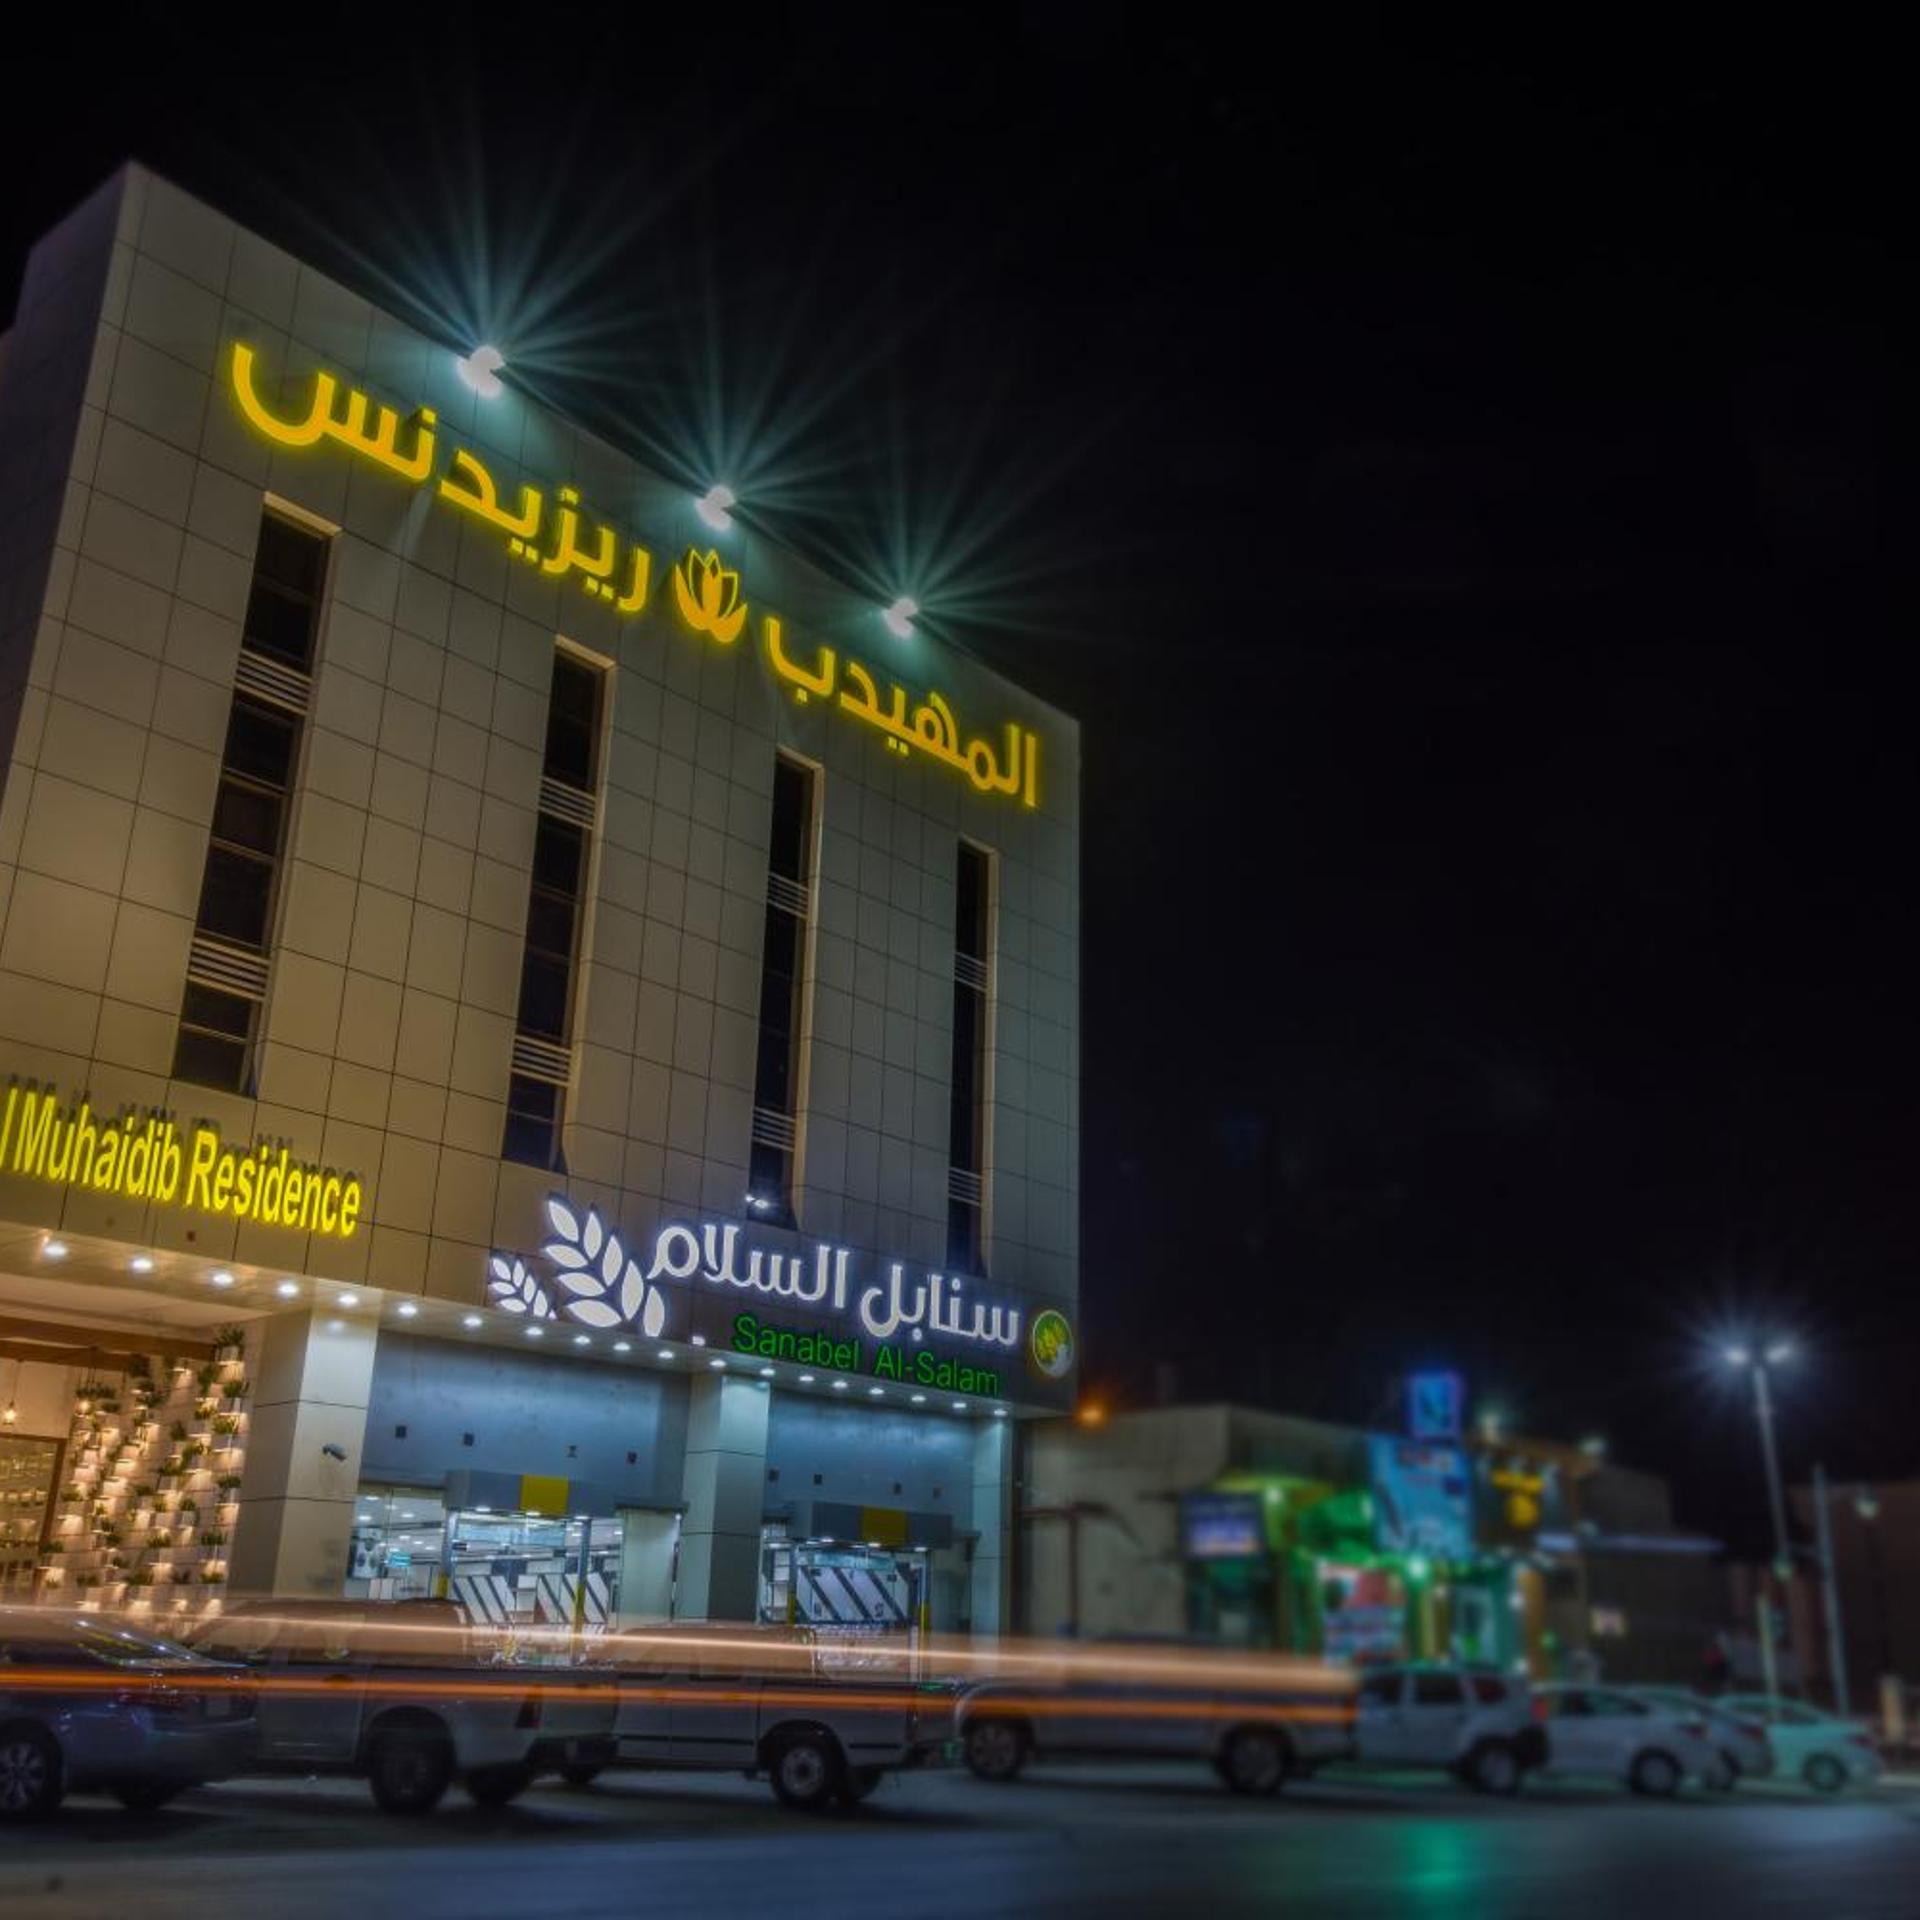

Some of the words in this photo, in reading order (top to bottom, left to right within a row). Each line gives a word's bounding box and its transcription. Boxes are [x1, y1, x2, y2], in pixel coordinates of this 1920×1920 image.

[232, 342, 652, 613] ريزيدنس
[765, 616, 1038, 808] المهيدب
[13, 1091, 182, 1202] Muhaidib
[187, 1129, 362, 1238] Residence
[646, 1224, 849, 1309] السلام
[860, 1263, 1020, 1344] سنابل
[733, 1314, 862, 1371] Sanabel
[873, 1345, 1001, 1398] Al-Salam
